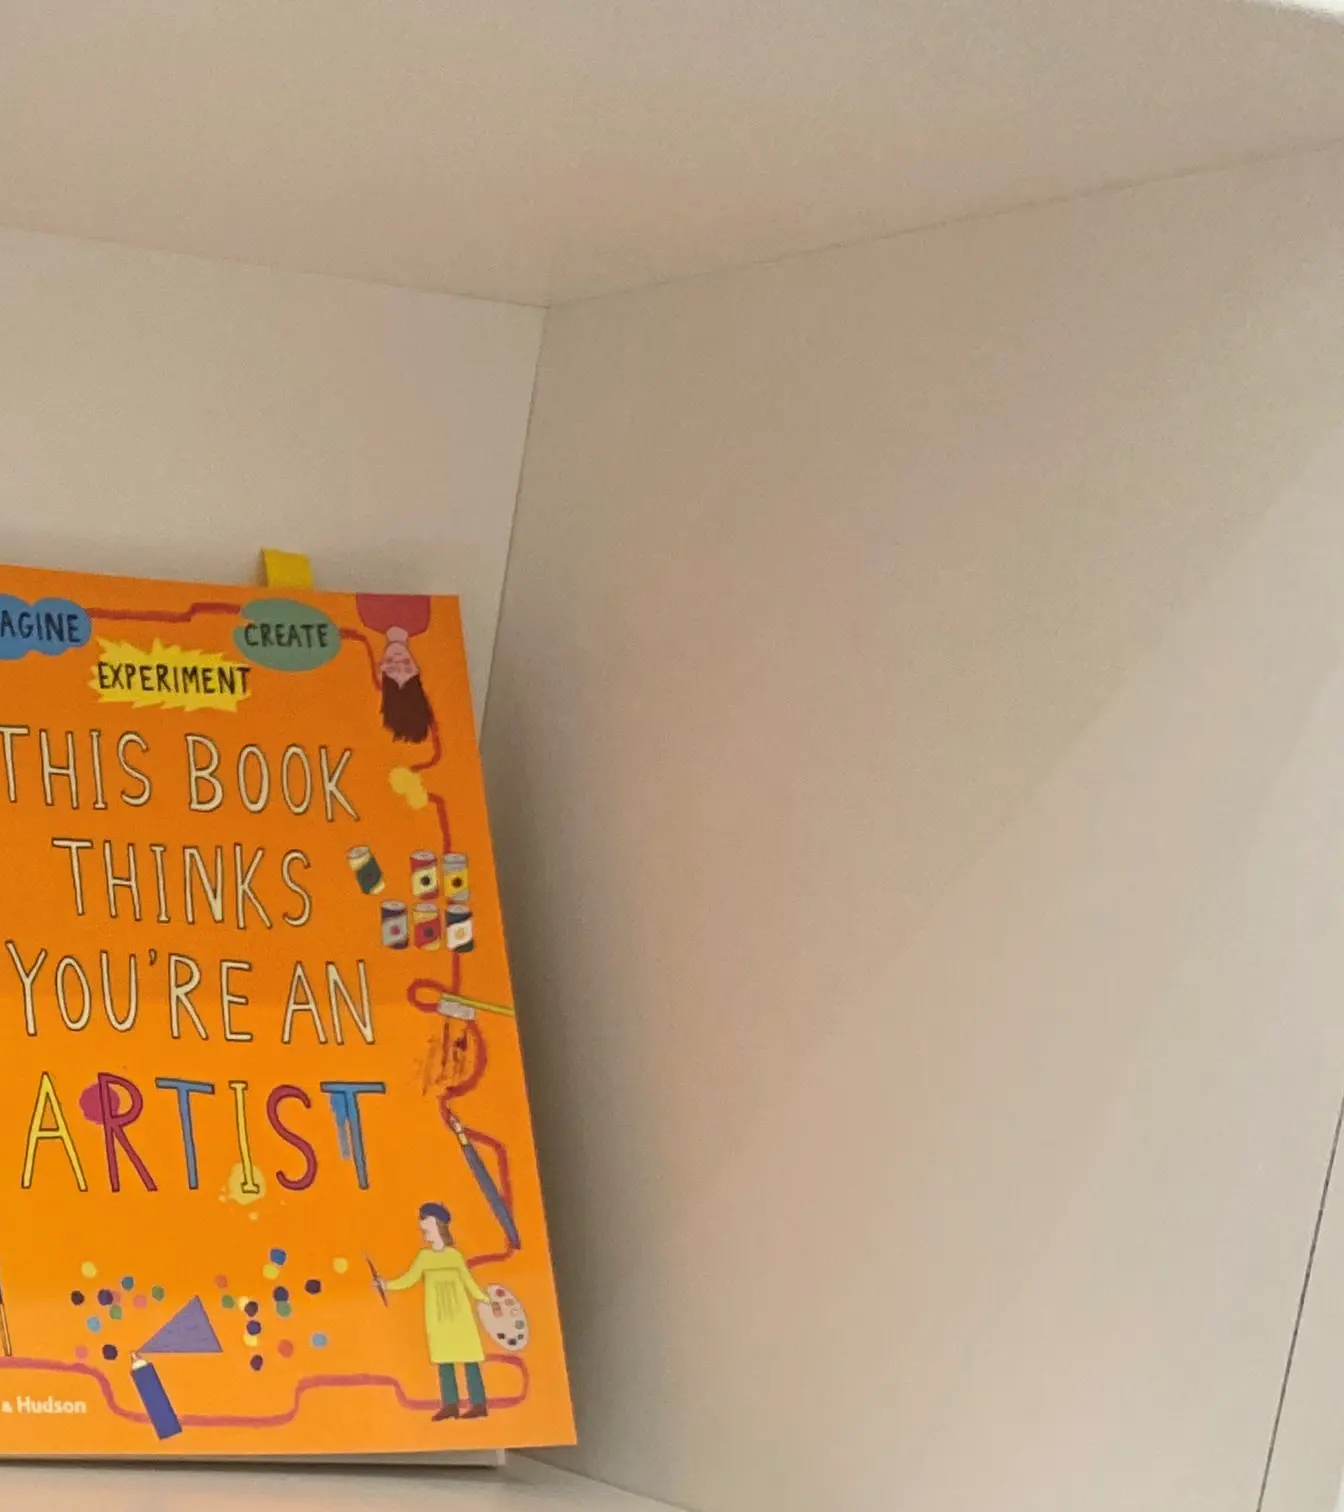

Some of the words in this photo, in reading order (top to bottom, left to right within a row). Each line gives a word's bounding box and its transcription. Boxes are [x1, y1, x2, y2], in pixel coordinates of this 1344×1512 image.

[244, 620, 330, 650] CREATE
[96, 662, 251, 697] EXPERIMENT
[188, 736, 360, 822] BOOK
[53, 836, 313, 930] THINKS
[5, 939, 253, 1043] YOU'RE
[282, 959, 375, 1047] AN
[21, 1073, 386, 1194] ARTIST
[17, 1396, 86, 1414] Hudson
